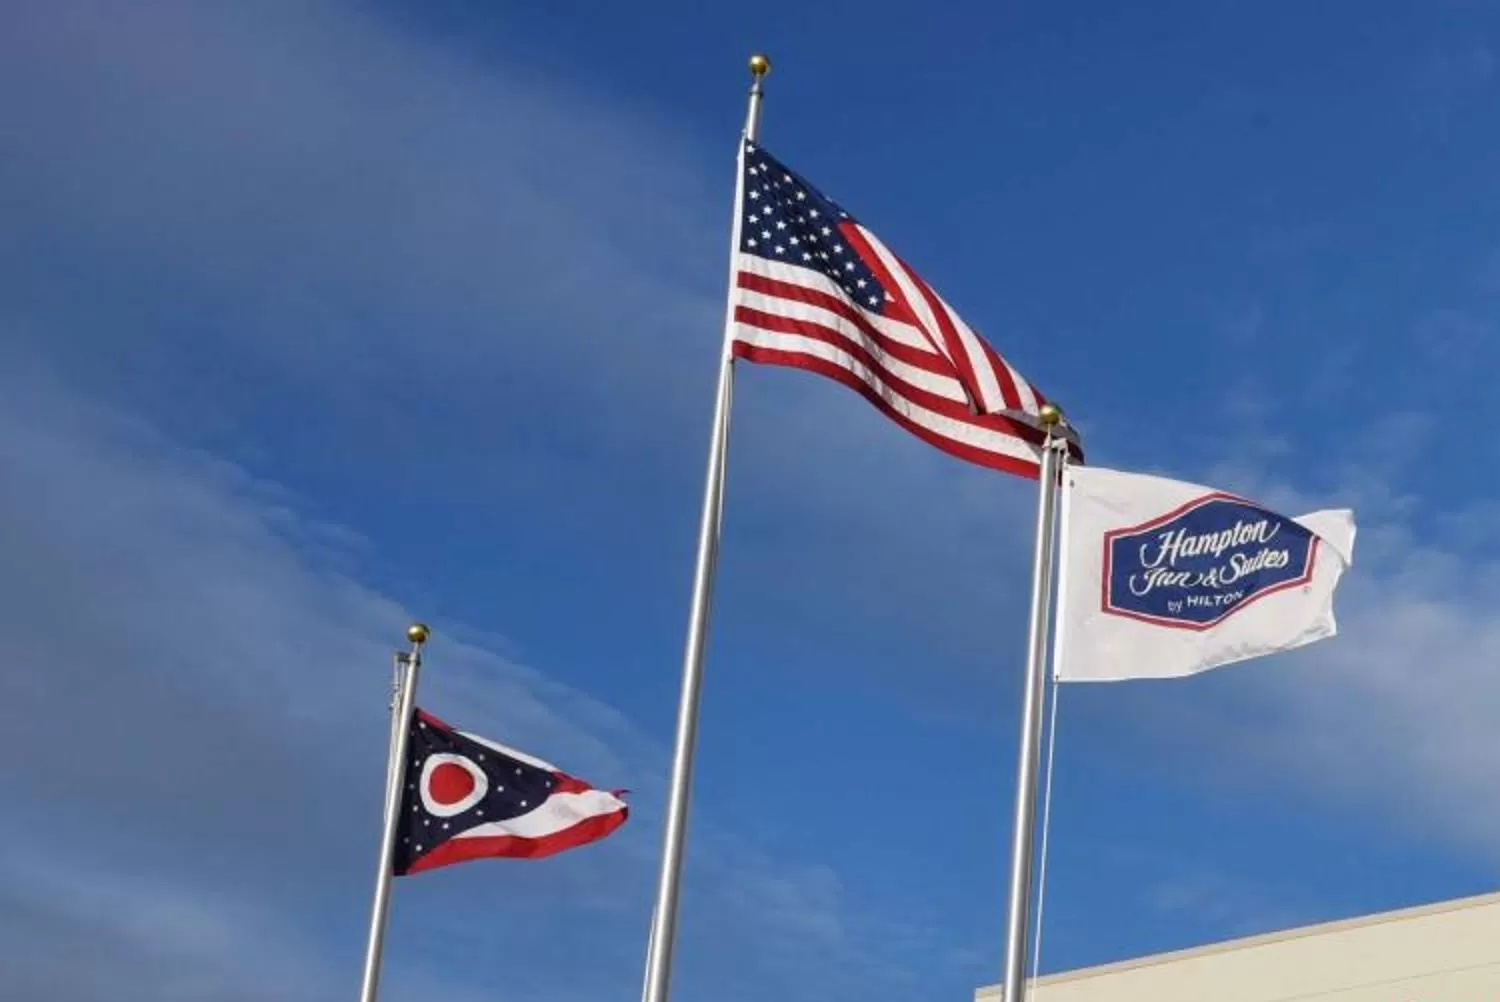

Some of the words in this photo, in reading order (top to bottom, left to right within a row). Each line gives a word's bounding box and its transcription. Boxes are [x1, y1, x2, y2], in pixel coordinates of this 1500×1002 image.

[1139, 519, 1281, 567] Hampton
[1129, 566, 1203, 596] Inn
[1202, 569, 1219, 588] &
[1219, 547, 1290, 584] Suites
[1186, 591, 1245, 608] HILTON
